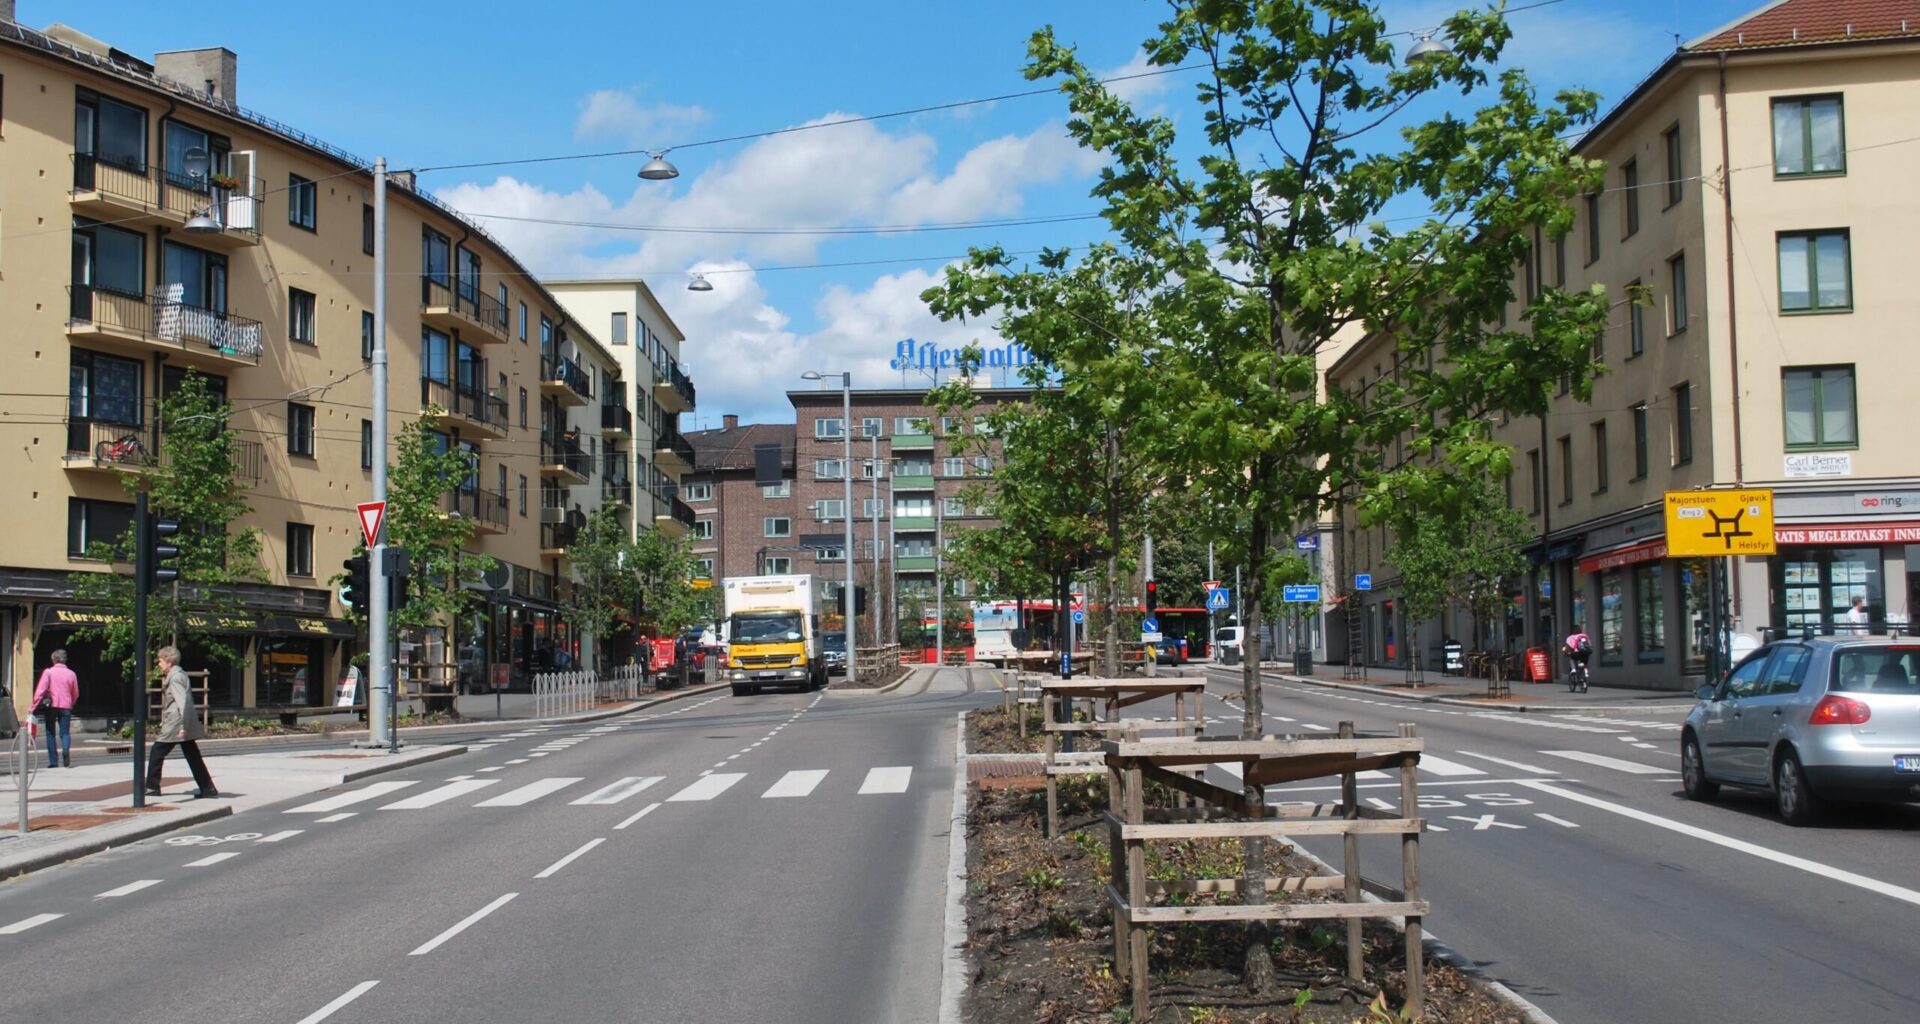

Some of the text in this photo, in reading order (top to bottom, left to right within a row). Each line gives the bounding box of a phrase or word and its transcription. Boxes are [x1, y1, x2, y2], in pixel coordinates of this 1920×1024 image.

[1786, 455, 1848, 466] Carl Berner
[1669, 495, 1716, 505] Majorstuen
[1740, 494, 1767, 504] Gjøvik
[1774, 530, 1805, 543] RATIS
[1808, 529, 1891, 542] MEGLERTAKST
